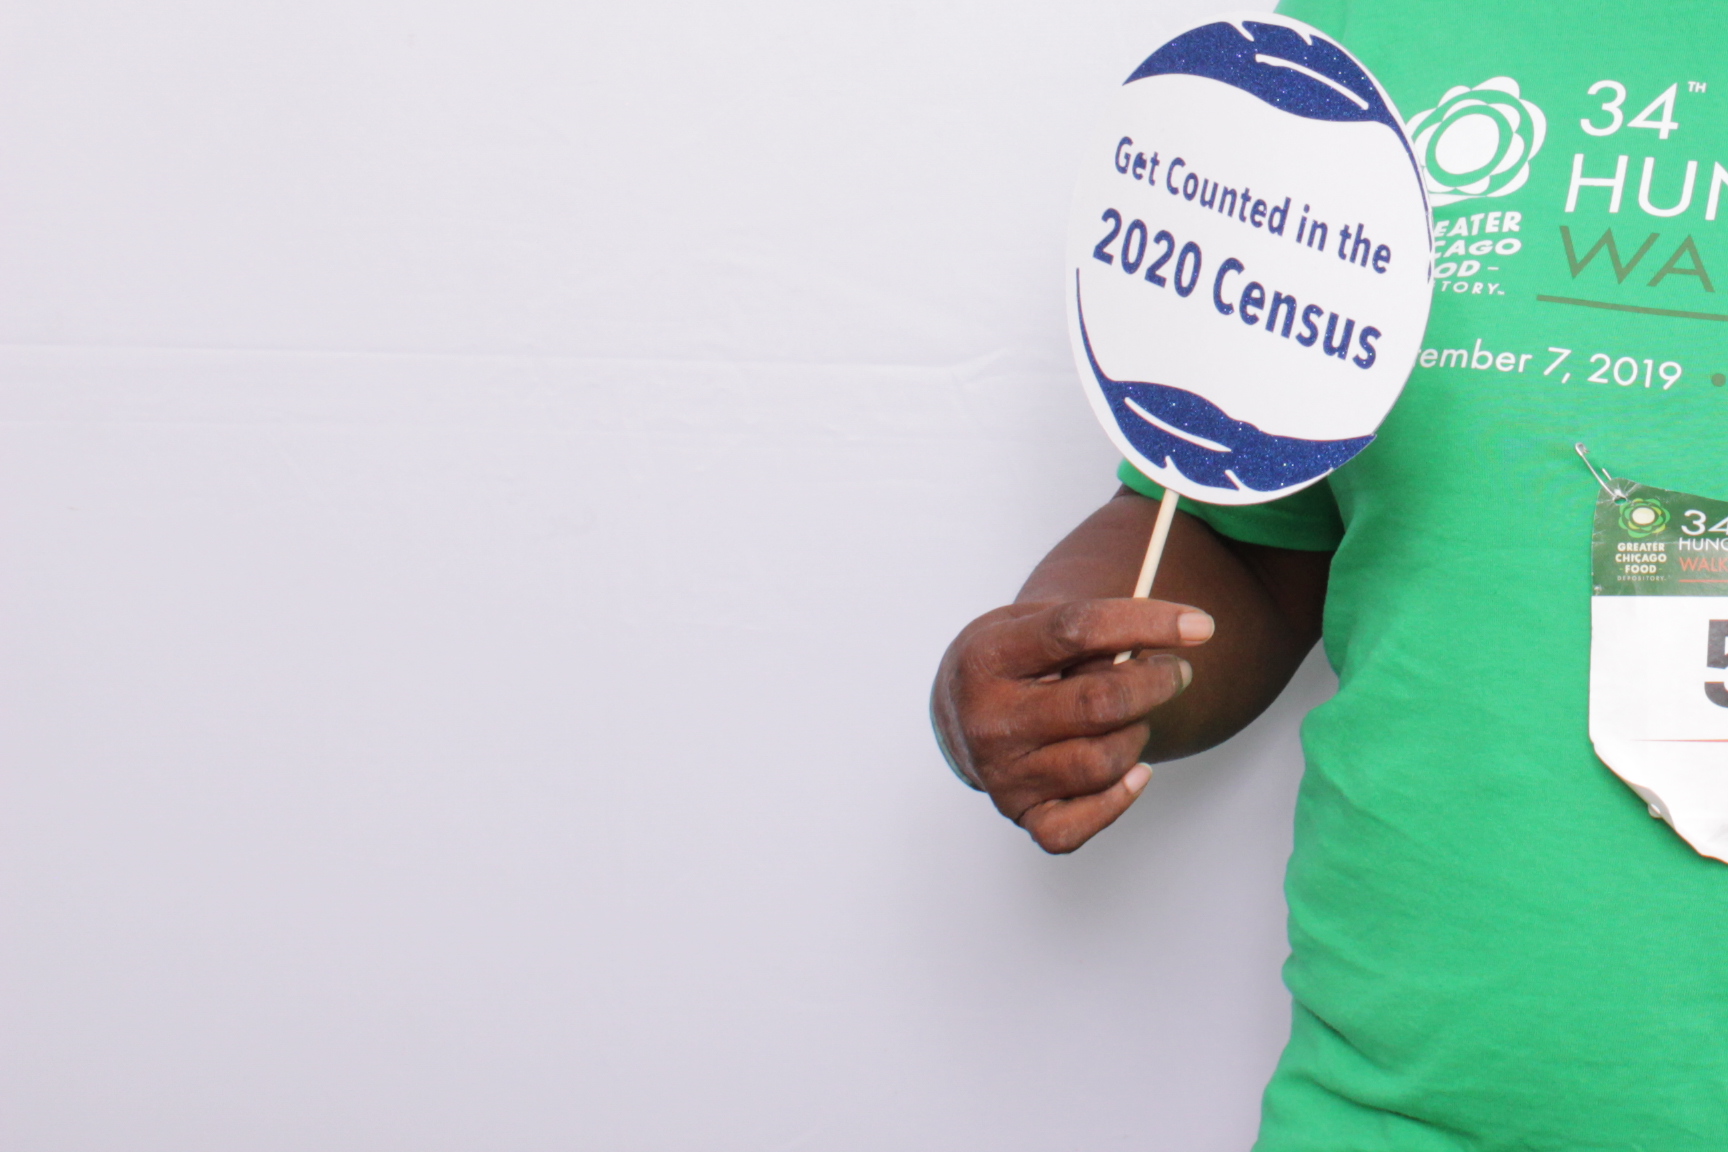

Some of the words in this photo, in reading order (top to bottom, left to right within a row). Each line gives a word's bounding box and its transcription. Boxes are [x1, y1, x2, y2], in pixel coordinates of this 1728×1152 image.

[1114, 136, 1160, 186] Get
[1167, 157, 1292, 237] Counted
[1296, 204, 1329, 253] in
[1338, 223, 1392, 274] the
[1432, 211, 1522, 238] EATER
[1433, 238, 1522, 259] CAGO
[1433, 259, 1482, 279] OD
[1092, 208, 1203, 298] 2020
[1213, 257, 1382, 370] Census
[1416, 338, 1533, 374] ember
[1543, 347, 1572, 384] 7,
[1587, 353, 1682, 390] 2019
[1617, 542, 1665, 552] GREATER
[1615, 553, 1668, 563] CHICAGO
[1624, 565, 1657, 574] FOOD
